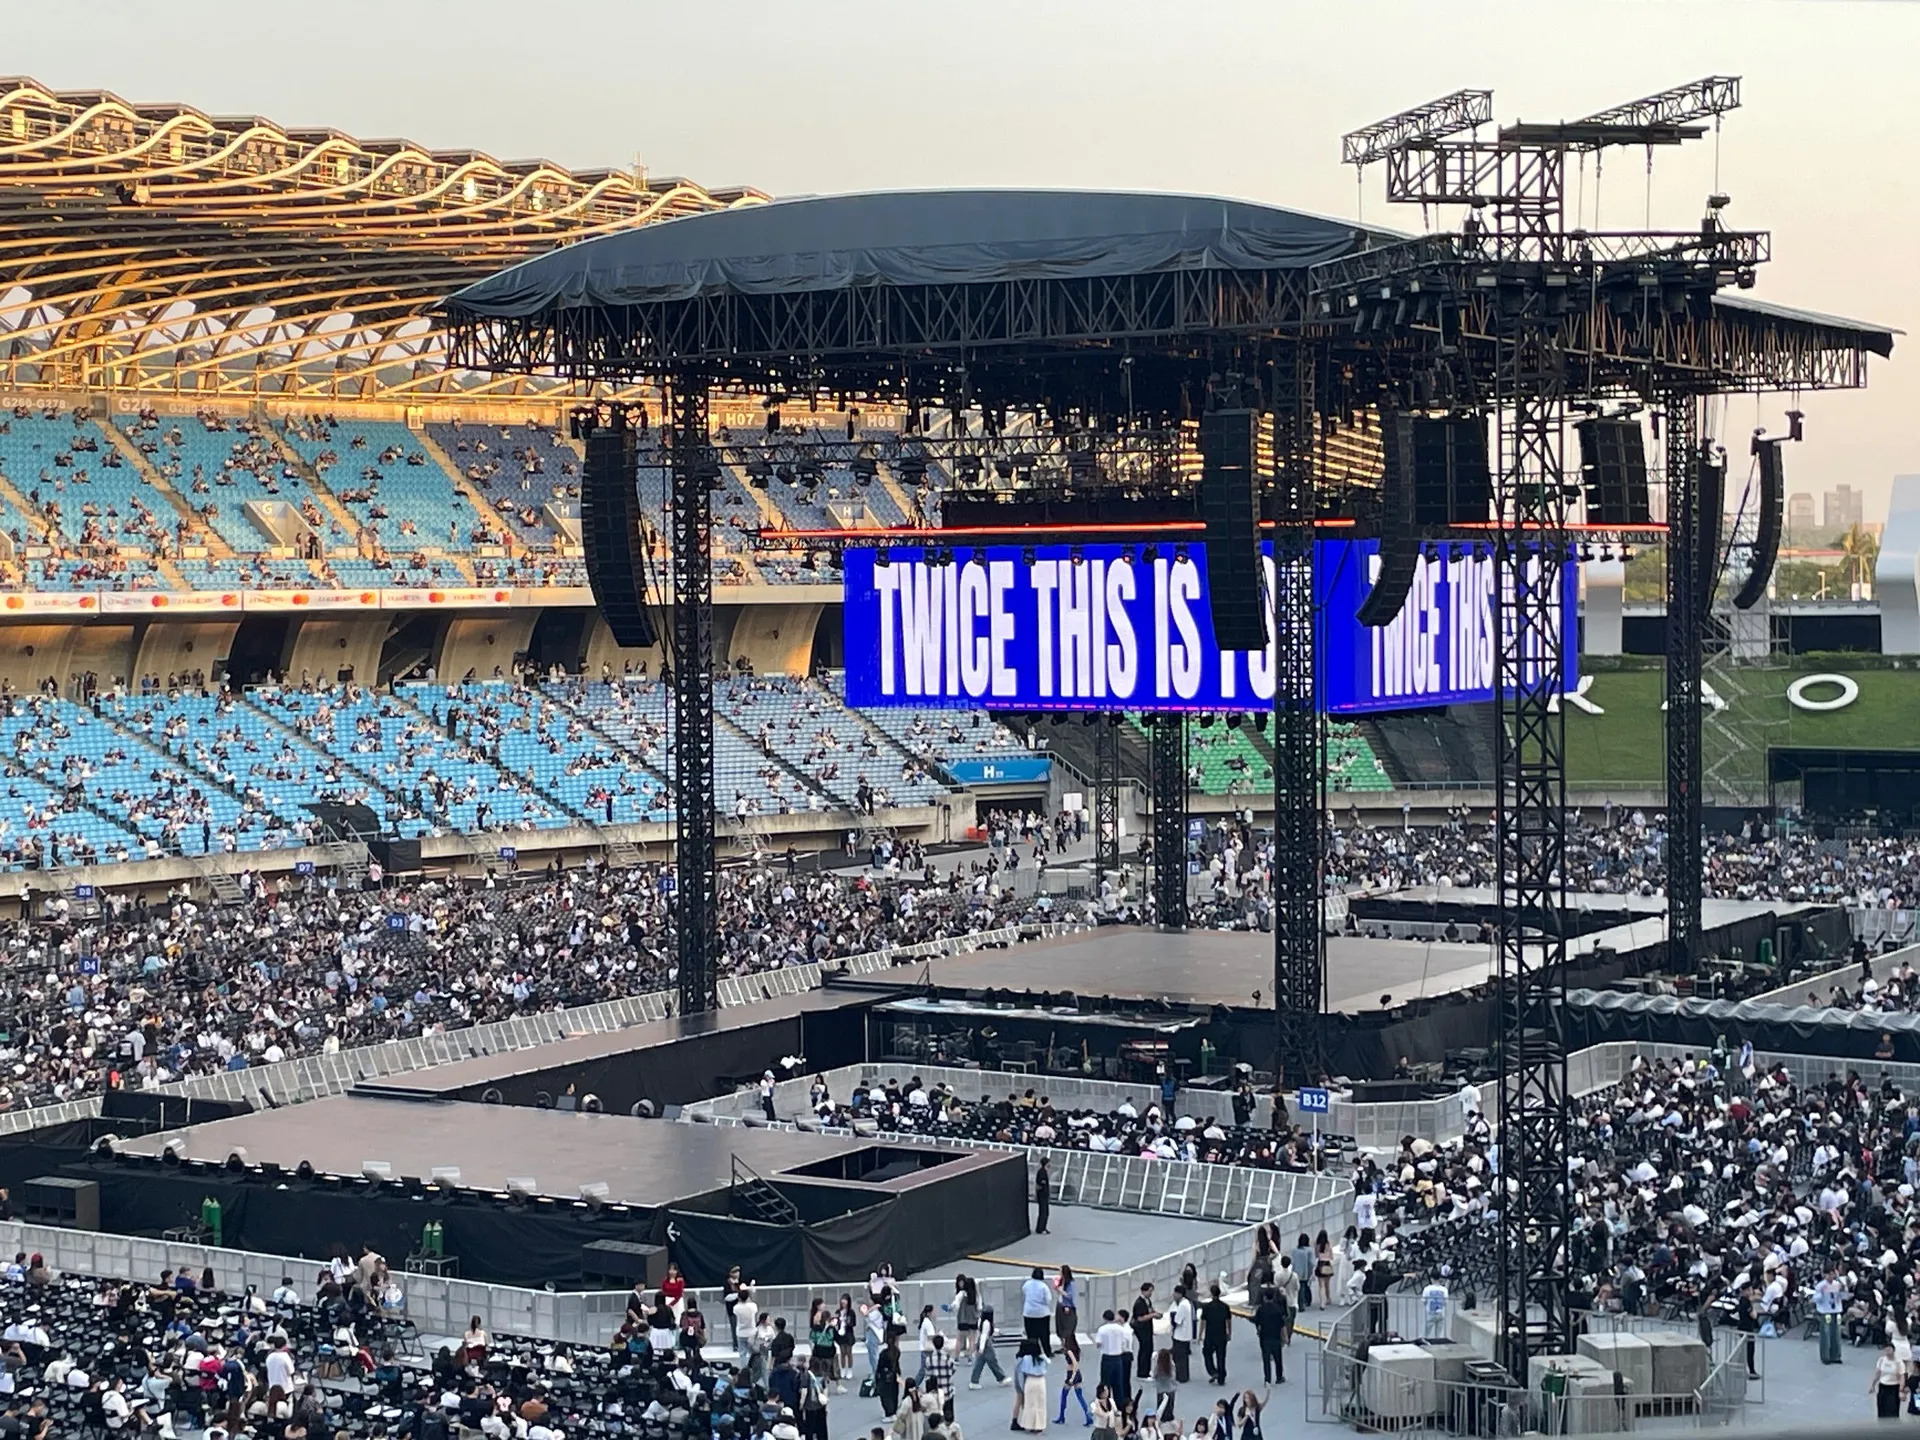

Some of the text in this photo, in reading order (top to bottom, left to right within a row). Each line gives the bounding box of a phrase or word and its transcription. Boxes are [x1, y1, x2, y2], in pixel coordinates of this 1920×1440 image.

[119, 397, 151, 412] G26
[725, 412, 755, 426] H07
[866, 414, 896, 428] H08
[261, 502, 272, 515] G
[560, 505, 570, 517] H
[843, 506, 852, 517] H
[874, 560, 1017, 697] TWICE
[1030, 557, 1138, 699] THIS
[1153, 556, 1202, 700] IS
[1446, 553, 1496, 690] THIS
[299, 863, 311, 872] D7
[1302, 1092, 1327, 1108] B12
